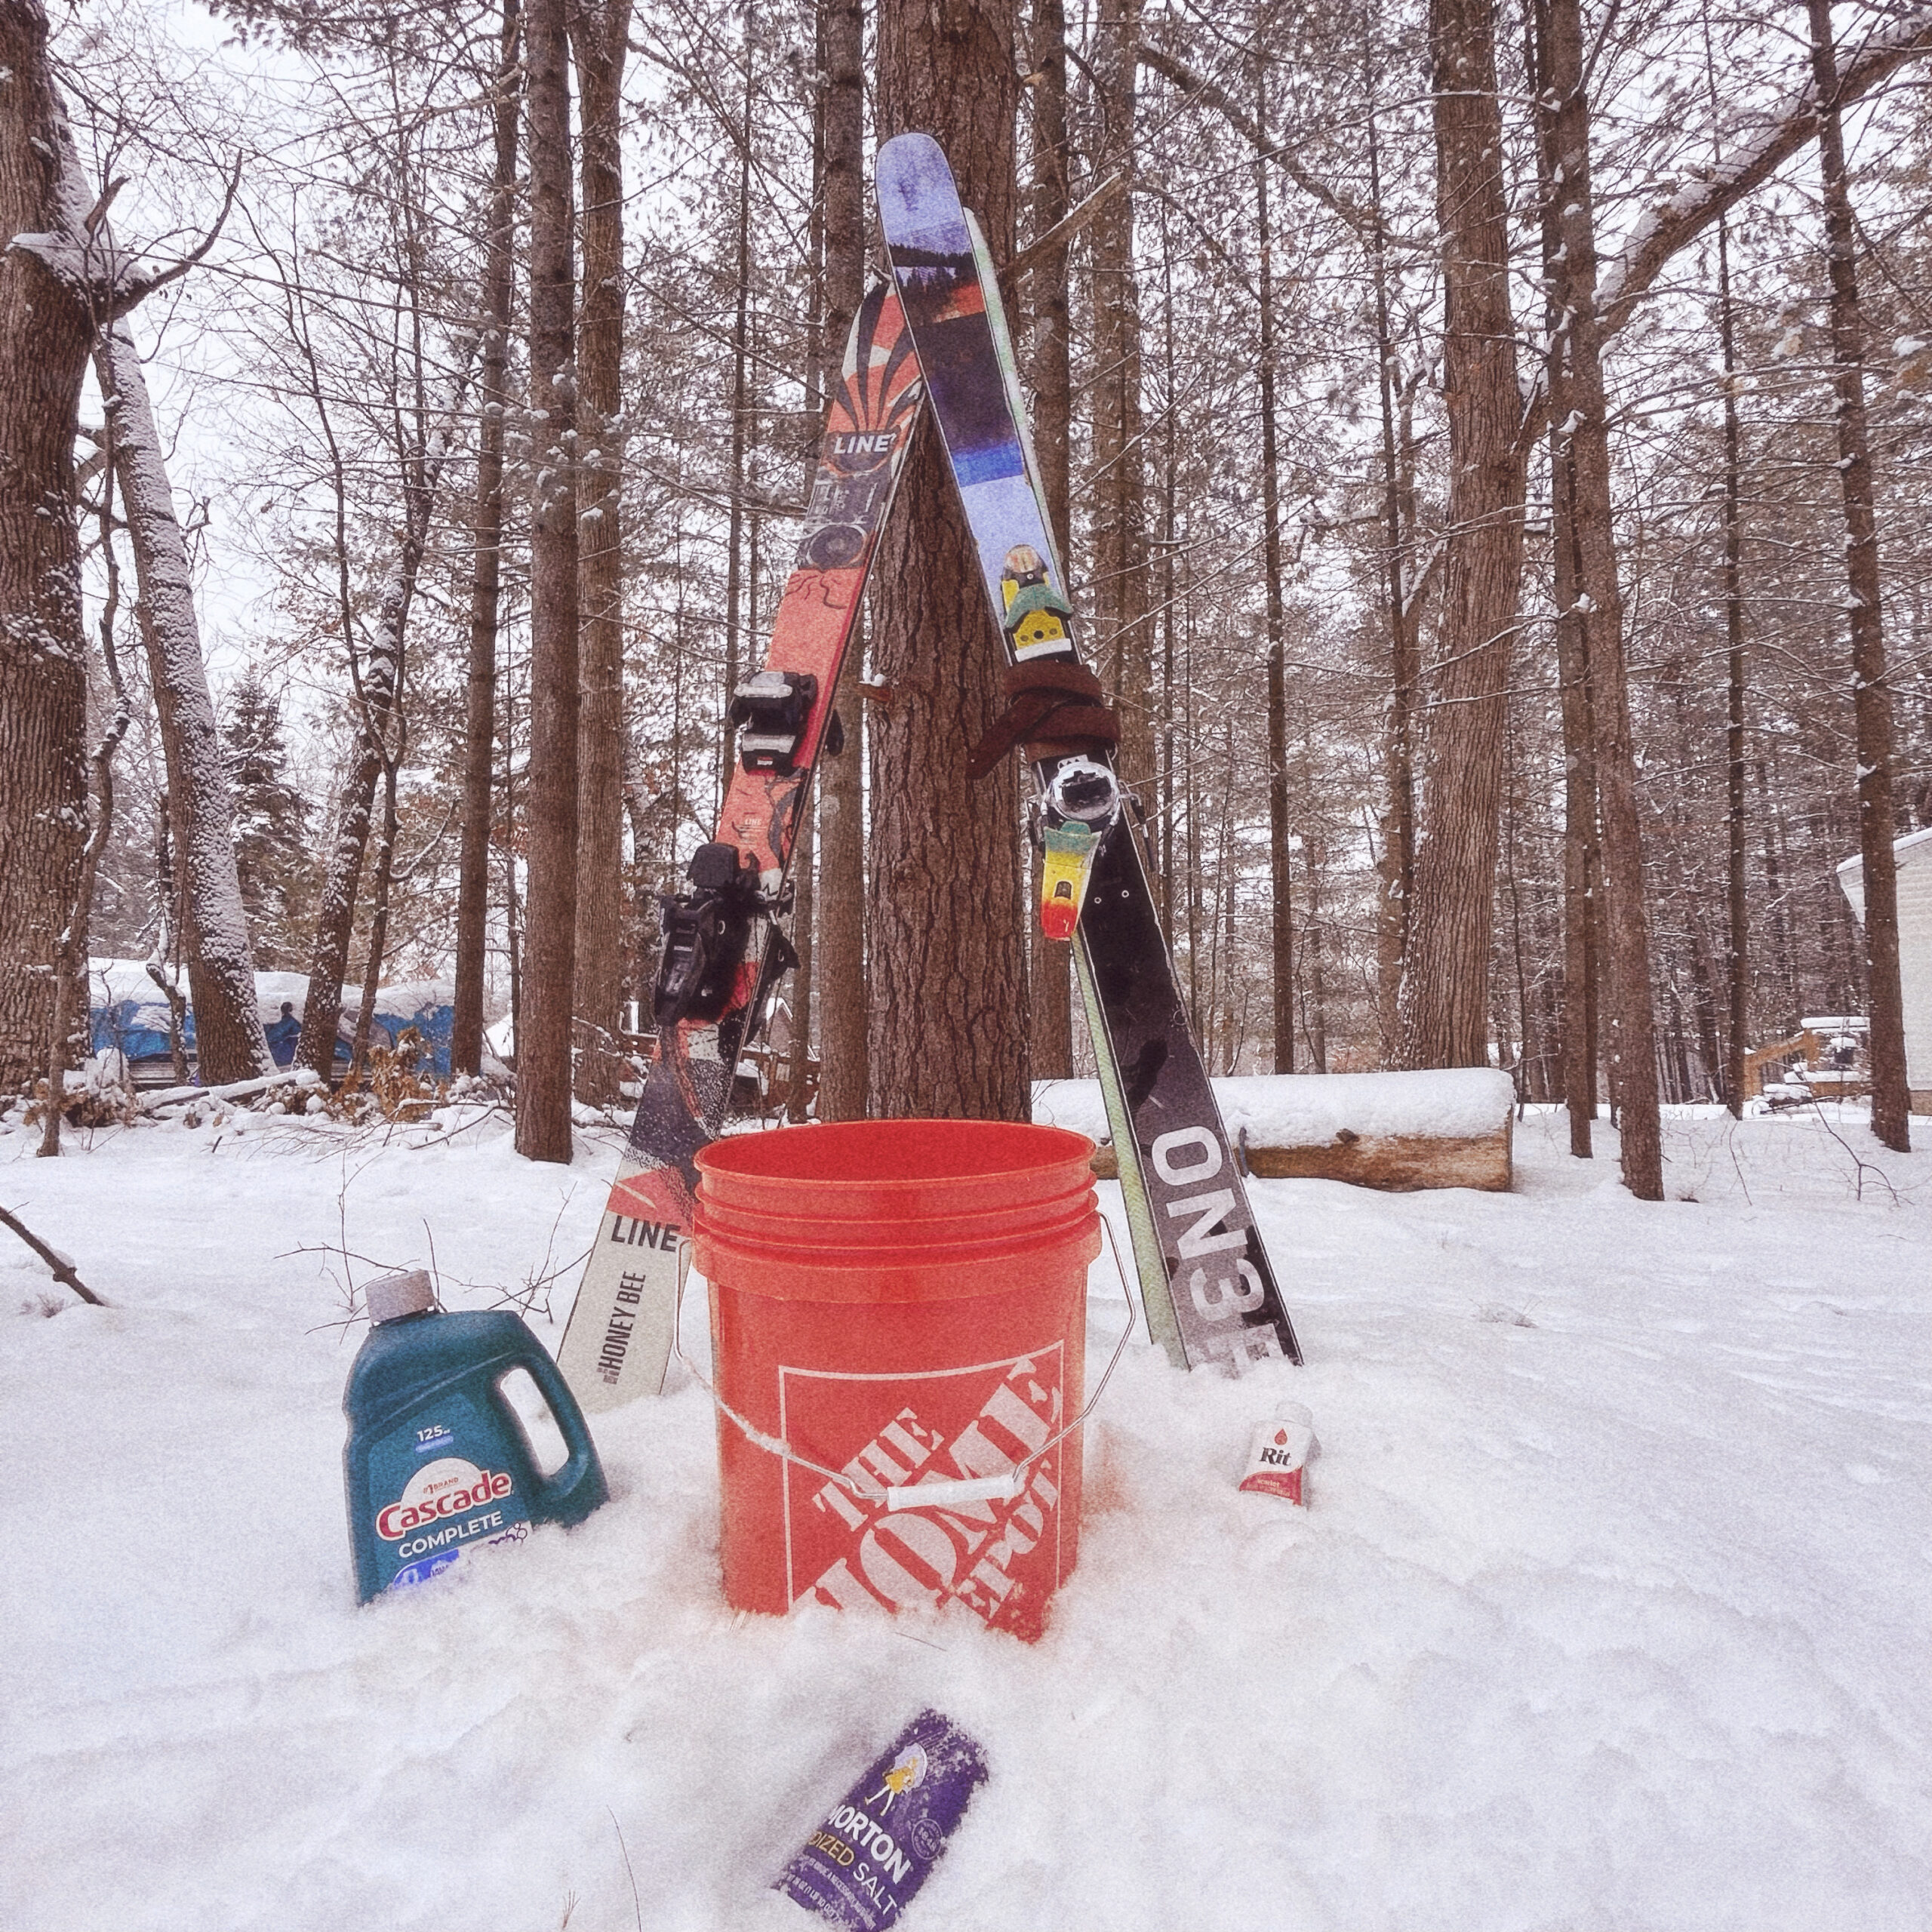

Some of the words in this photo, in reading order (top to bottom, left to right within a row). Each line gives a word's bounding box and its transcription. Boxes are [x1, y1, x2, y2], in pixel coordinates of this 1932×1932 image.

[833, 435, 890, 454] LINE
[611, 1214, 681, 1253] LINE
[616, 1271, 646, 1304] BEE
[598, 1306, 637, 1371] HONEY
[417, 1425, 443, 1442] 125
[812, 1407, 945, 1532] THE
[1259, 1447, 1292, 1466] Rit
[378, 1472, 511, 1539] Cascade
[433, 1477, 459, 1491] BRAND
[398, 1511, 503, 1558] COMPLETE
[940, 1459, 1059, 1623] EPOT
[853, 1862, 897, 1915] SALT
